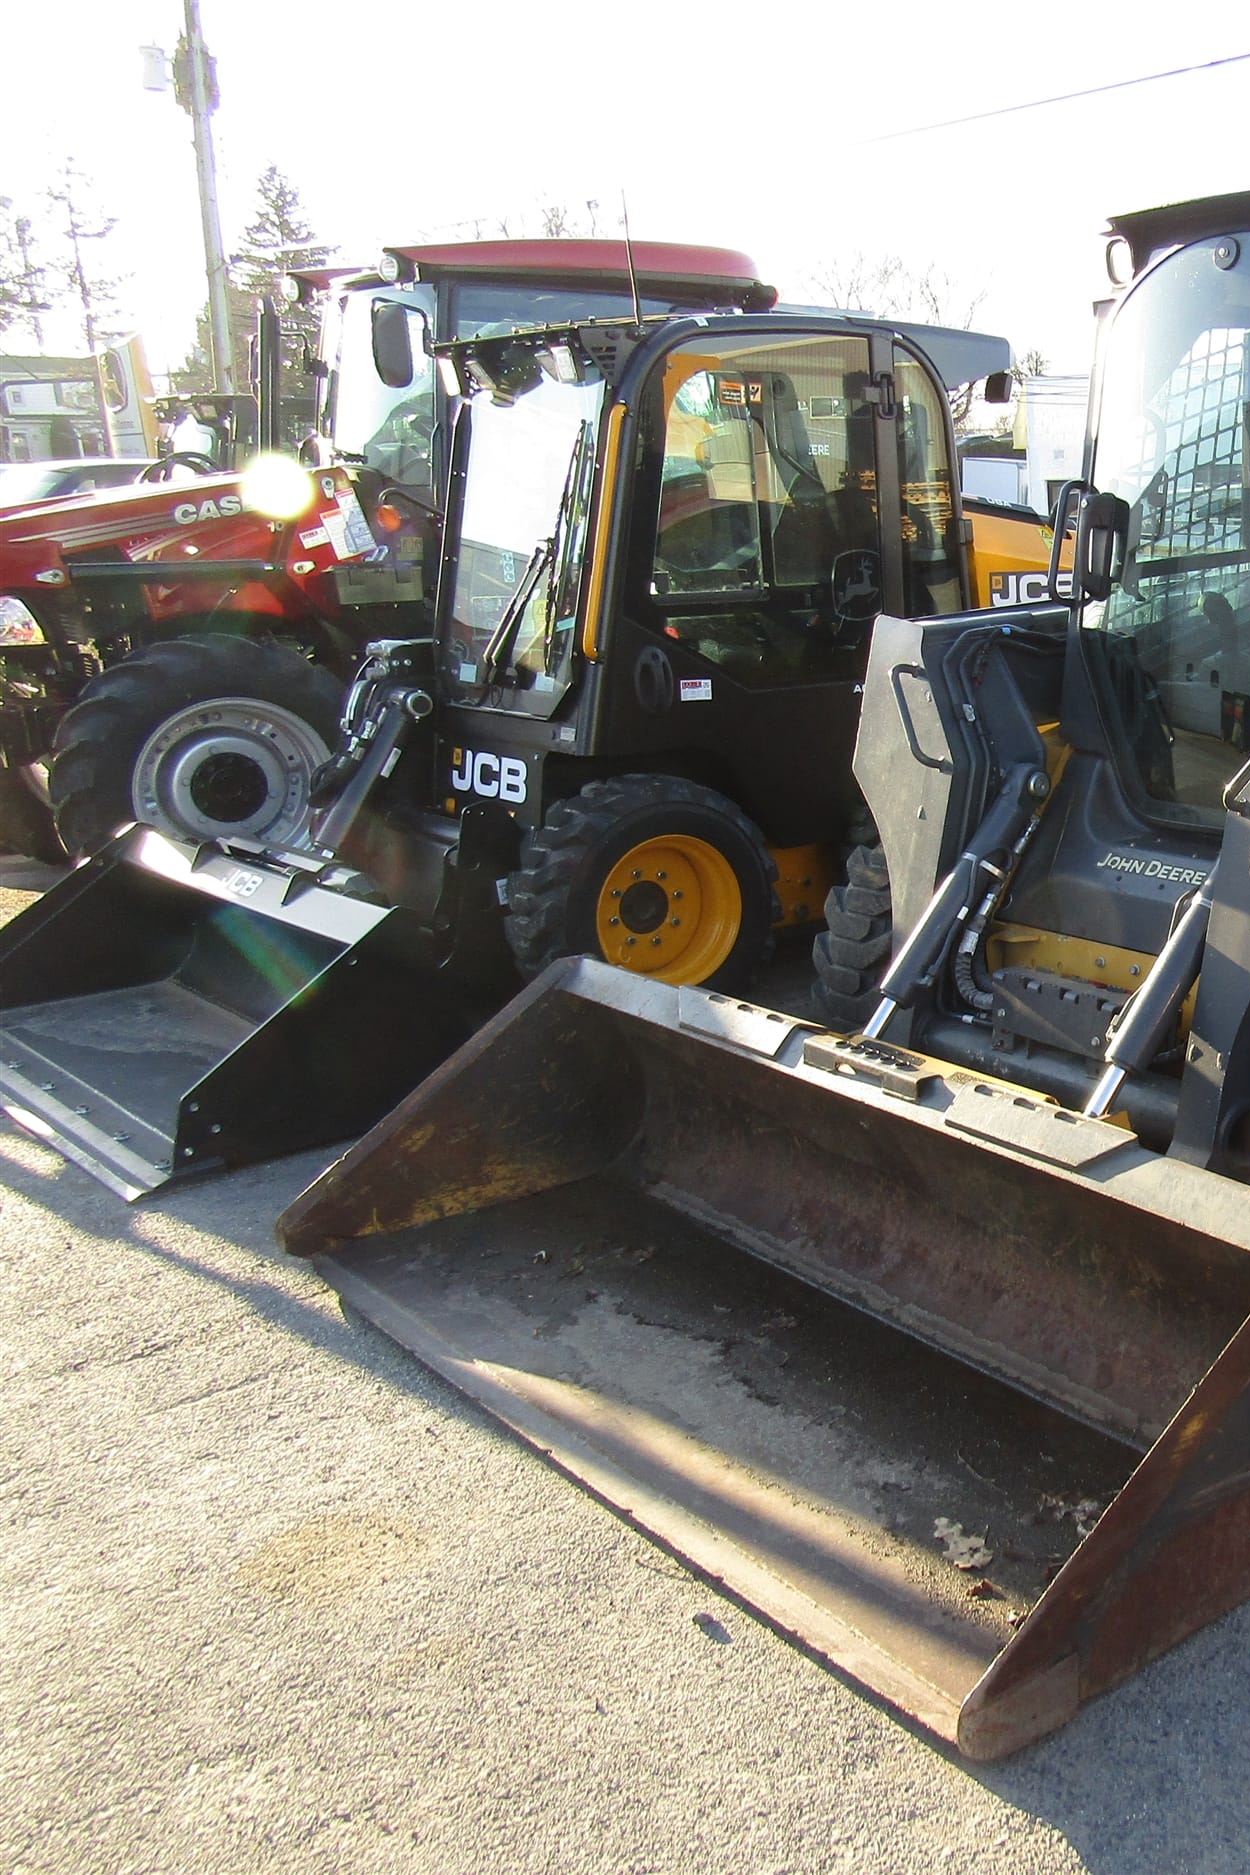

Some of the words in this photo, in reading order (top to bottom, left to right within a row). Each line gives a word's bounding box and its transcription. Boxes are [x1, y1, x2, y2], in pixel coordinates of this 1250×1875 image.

[174, 496, 250, 525] CAS
[452, 749, 528, 804] JCB
[1097, 852, 1146, 874] JOHN
[1144, 860, 1207, 886] DEERE
